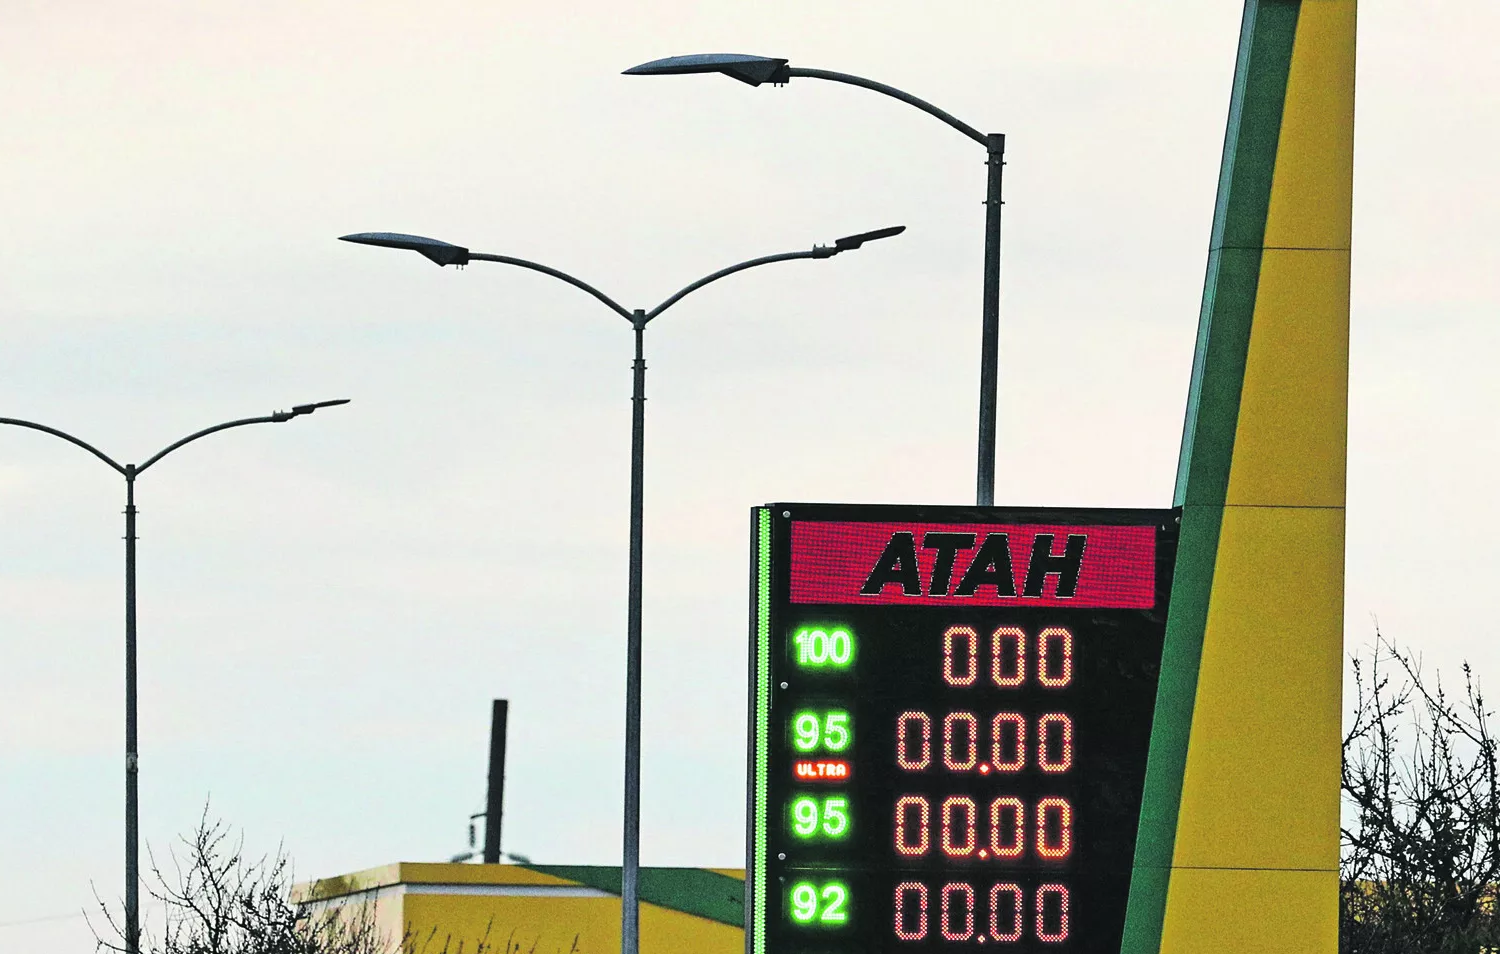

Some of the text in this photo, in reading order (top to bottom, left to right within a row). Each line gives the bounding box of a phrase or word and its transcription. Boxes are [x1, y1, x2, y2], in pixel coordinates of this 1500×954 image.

[859, 531, 1088, 599] АТАН
[795, 626, 1072, 687] 100 000
[795, 711, 1072, 776] 95 00.00
[797, 763, 847, 777] ULTRA
[794, 796, 1071, 860] 95 00.00
[793, 881, 1069, 944] 92 00.00
